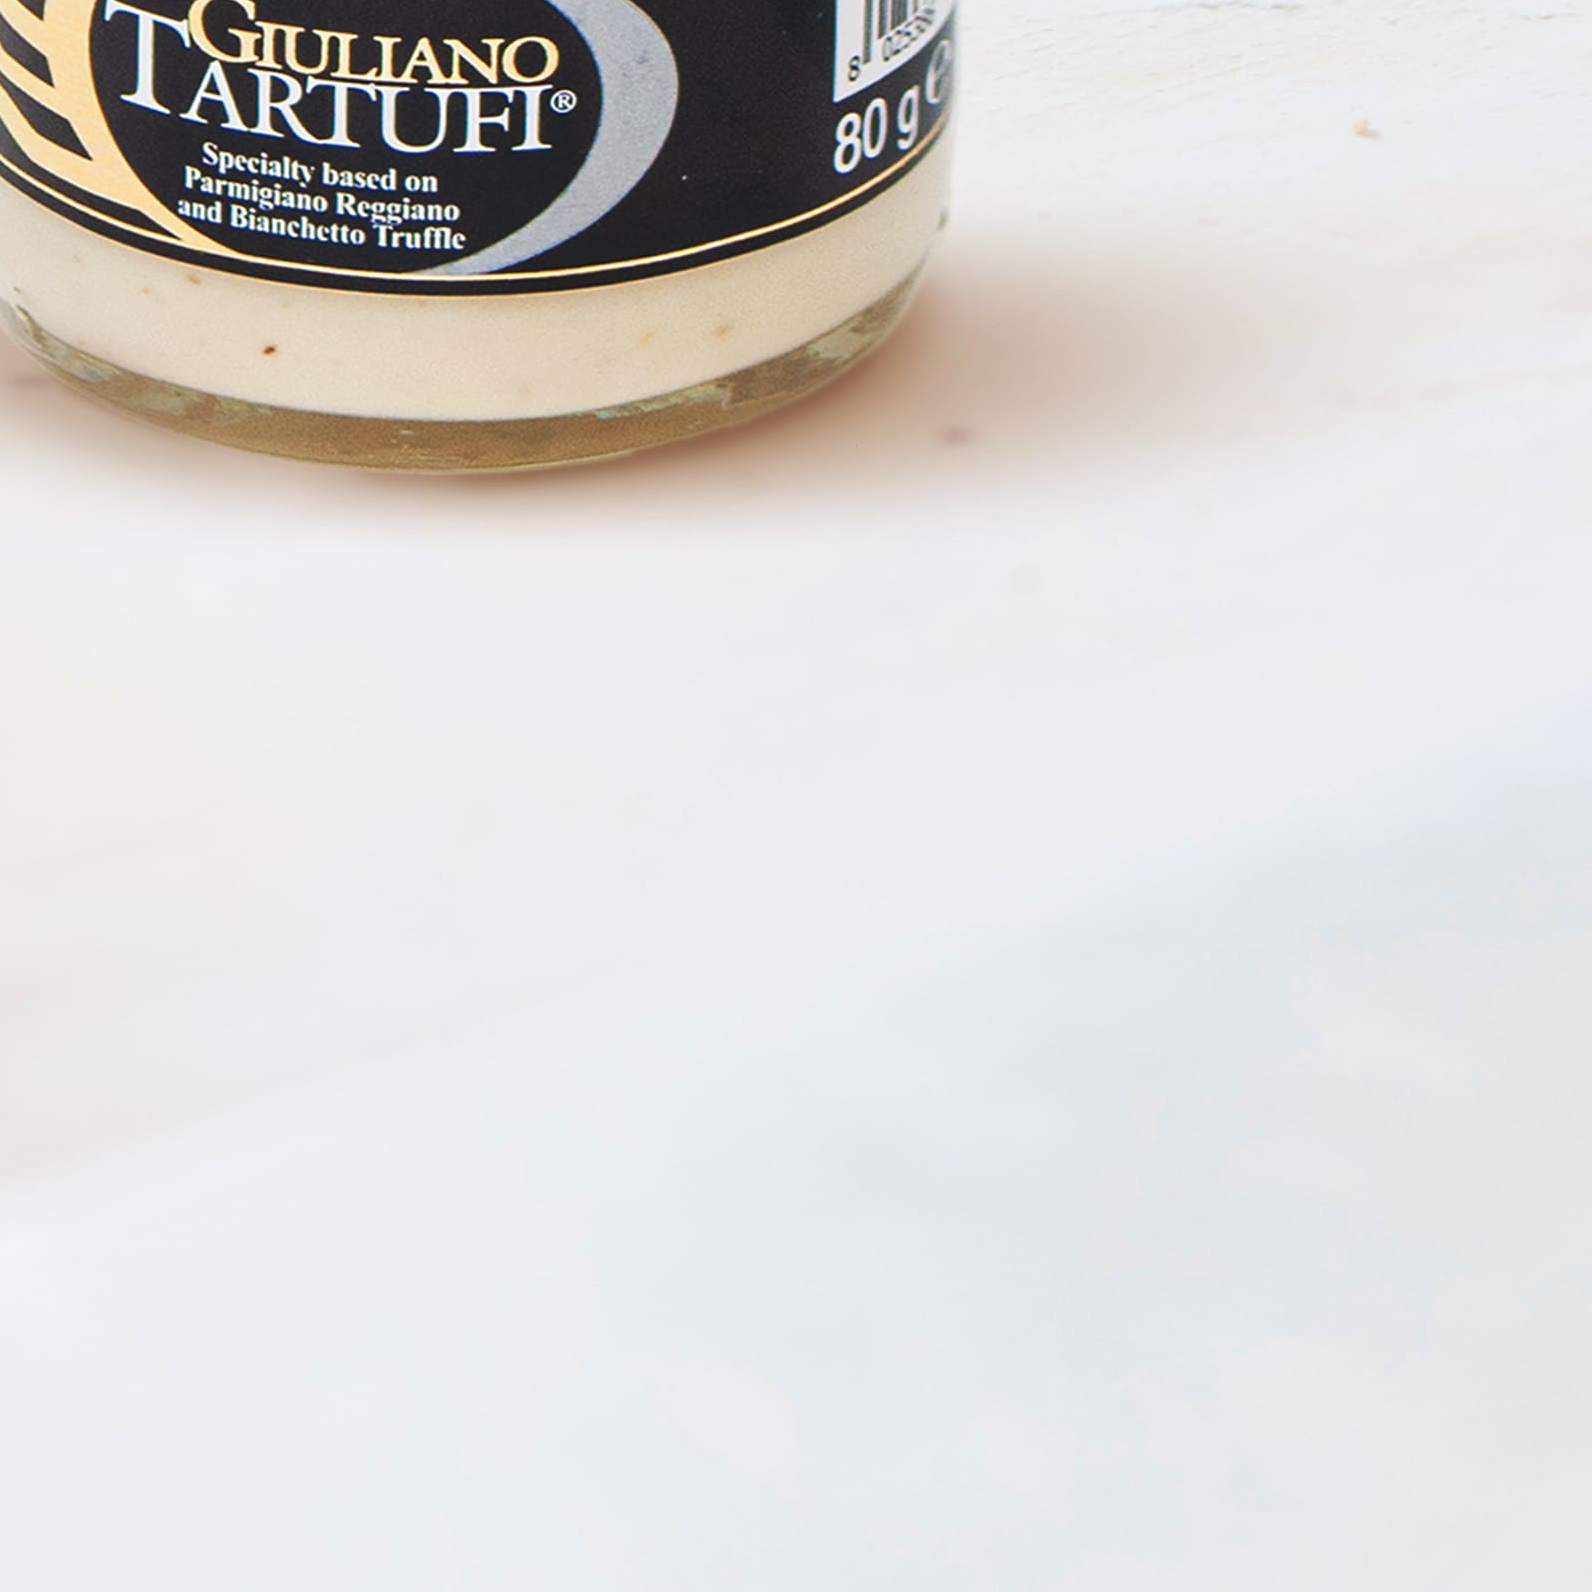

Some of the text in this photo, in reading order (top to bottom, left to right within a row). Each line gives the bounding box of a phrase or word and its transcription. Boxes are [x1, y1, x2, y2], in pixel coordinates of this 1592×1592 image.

[846, 55, 862, 83] 8
[834, 95, 889, 175] 80
[896, 85, 919, 151] g
[201, 141, 439, 193] Specialty based on
[184, 165, 461, 228] Parmigiano Reggiano
[177, 198, 467, 250] and Bianchetto Truffle
